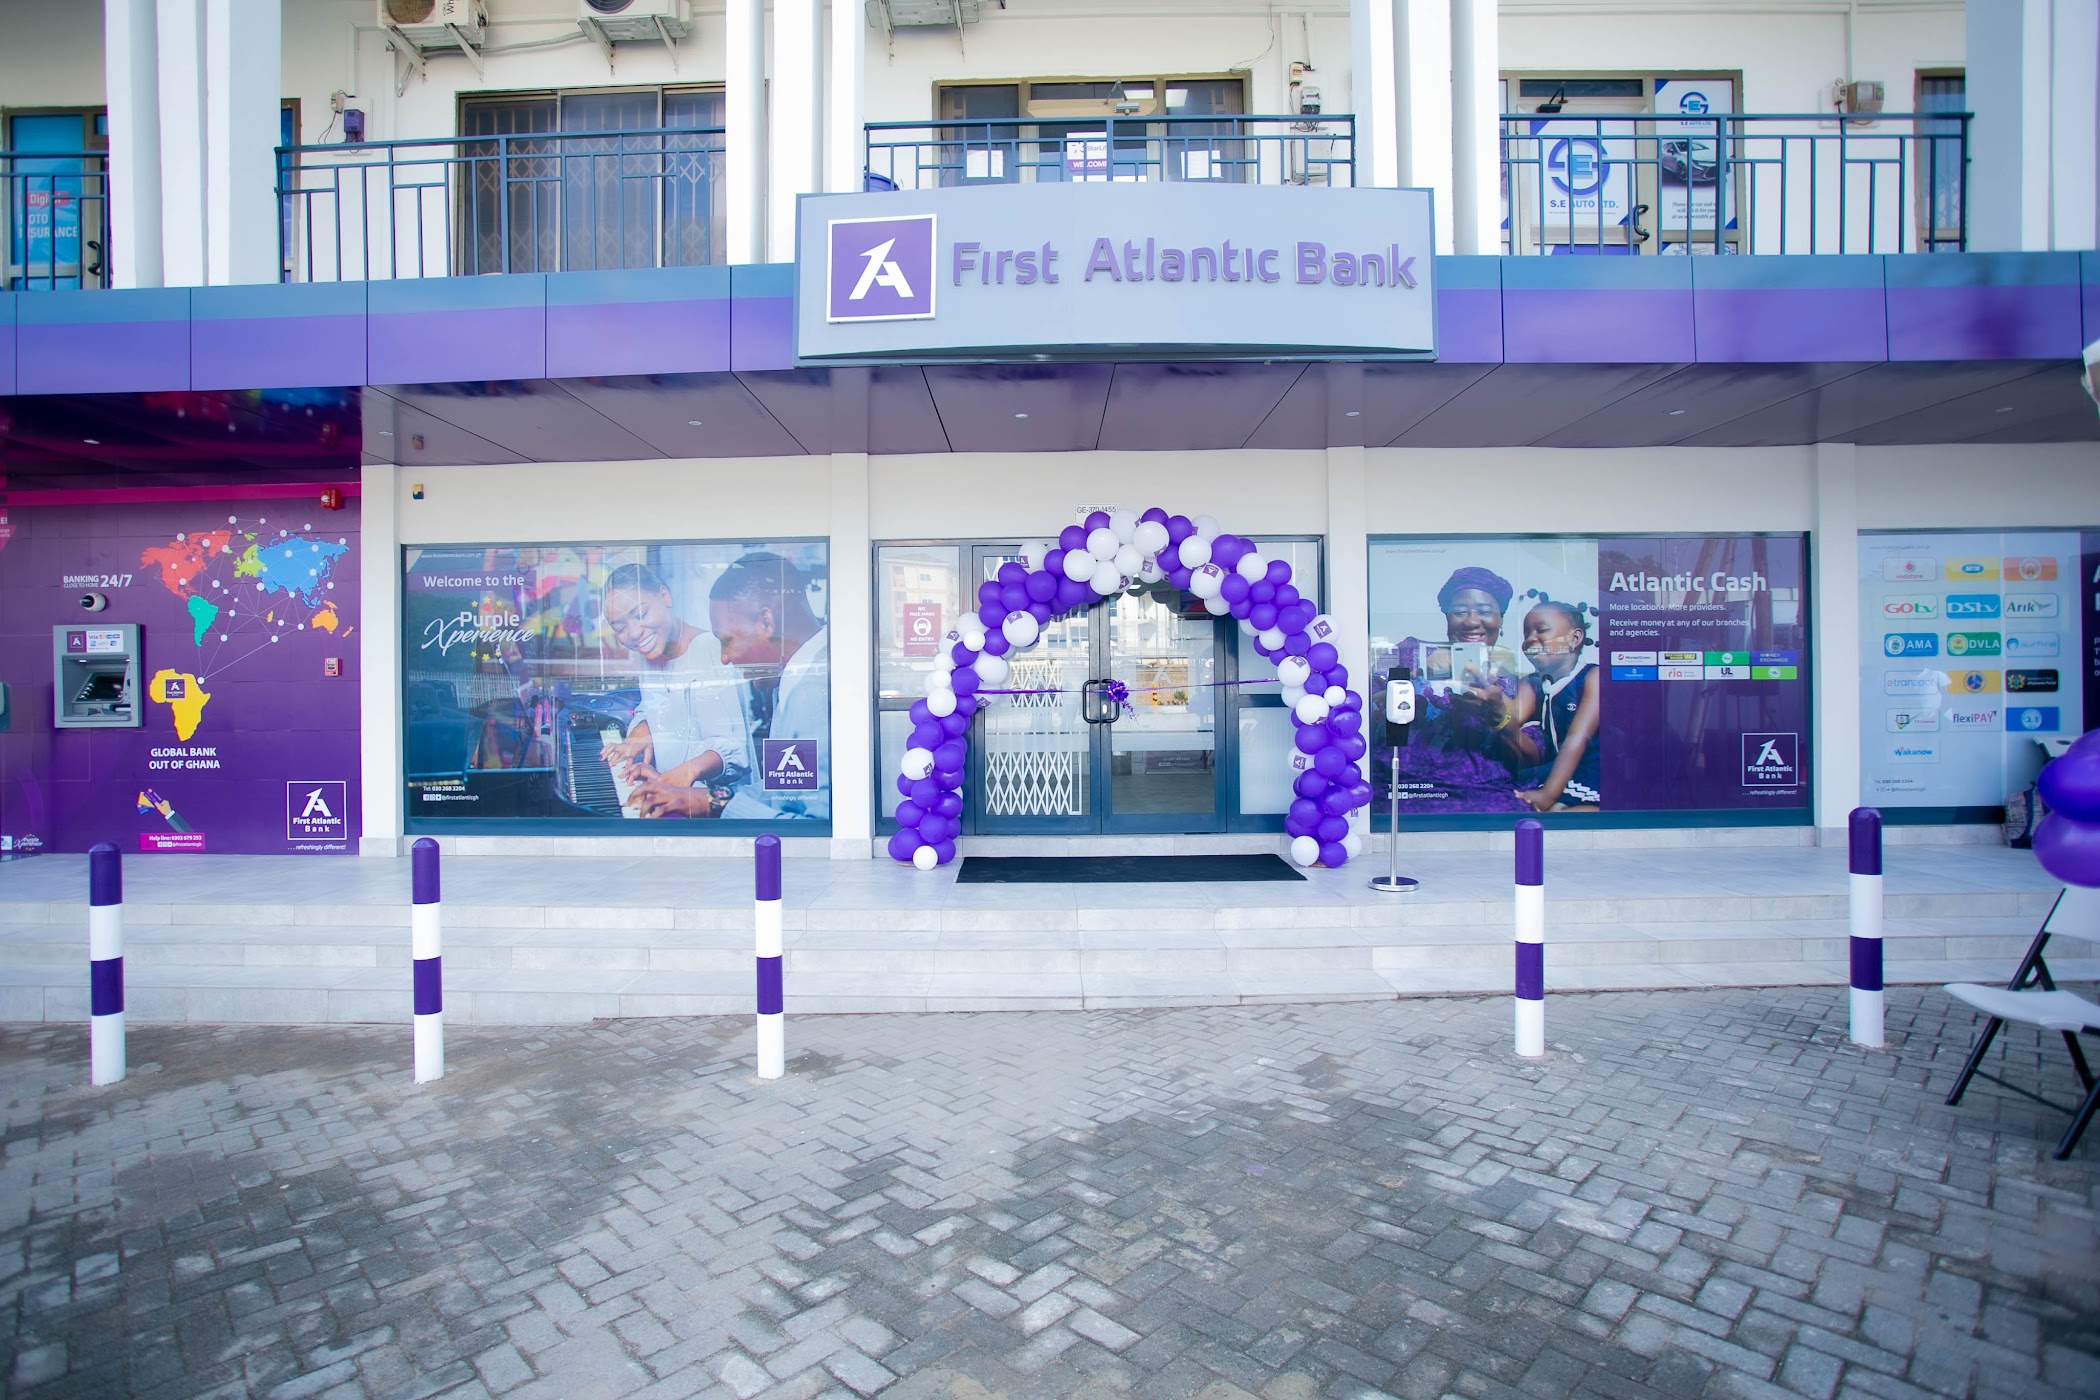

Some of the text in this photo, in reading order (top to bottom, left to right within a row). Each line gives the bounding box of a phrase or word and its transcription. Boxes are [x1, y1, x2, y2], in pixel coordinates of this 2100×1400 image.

[1550, 199, 1566, 208] S.E
[952, 237, 1418, 289] First Atlantic Bank
[63, 574, 133, 588] BANKING 24/7
[423, 574, 525, 587] Welcome to the
[1609, 571, 1767, 592] Atlantic Cash
[1689, 603, 1726, 612] providers.
[1884, 603, 1936, 614] GOtv
[1947, 602, 1999, 613] DStv
[2006, 602, 2035, 612] Arik
[460, 610, 520, 630] Purple
[1640, 620, 1668, 628] money
[1676, 620, 1690, 628] any
[421, 616, 535, 657] Xperience
[1626, 630, 1660, 638] agencies.
[1906, 640, 1932, 649] AMA
[1969, 640, 2000, 649] DVLA
[1668, 668, 1682, 678] ria
[1953, 713, 1994, 723] flexiPAY
[150, 748, 216, 756] GLOBAL BANK
[149, 760, 220, 769] OUT OF GHANA
